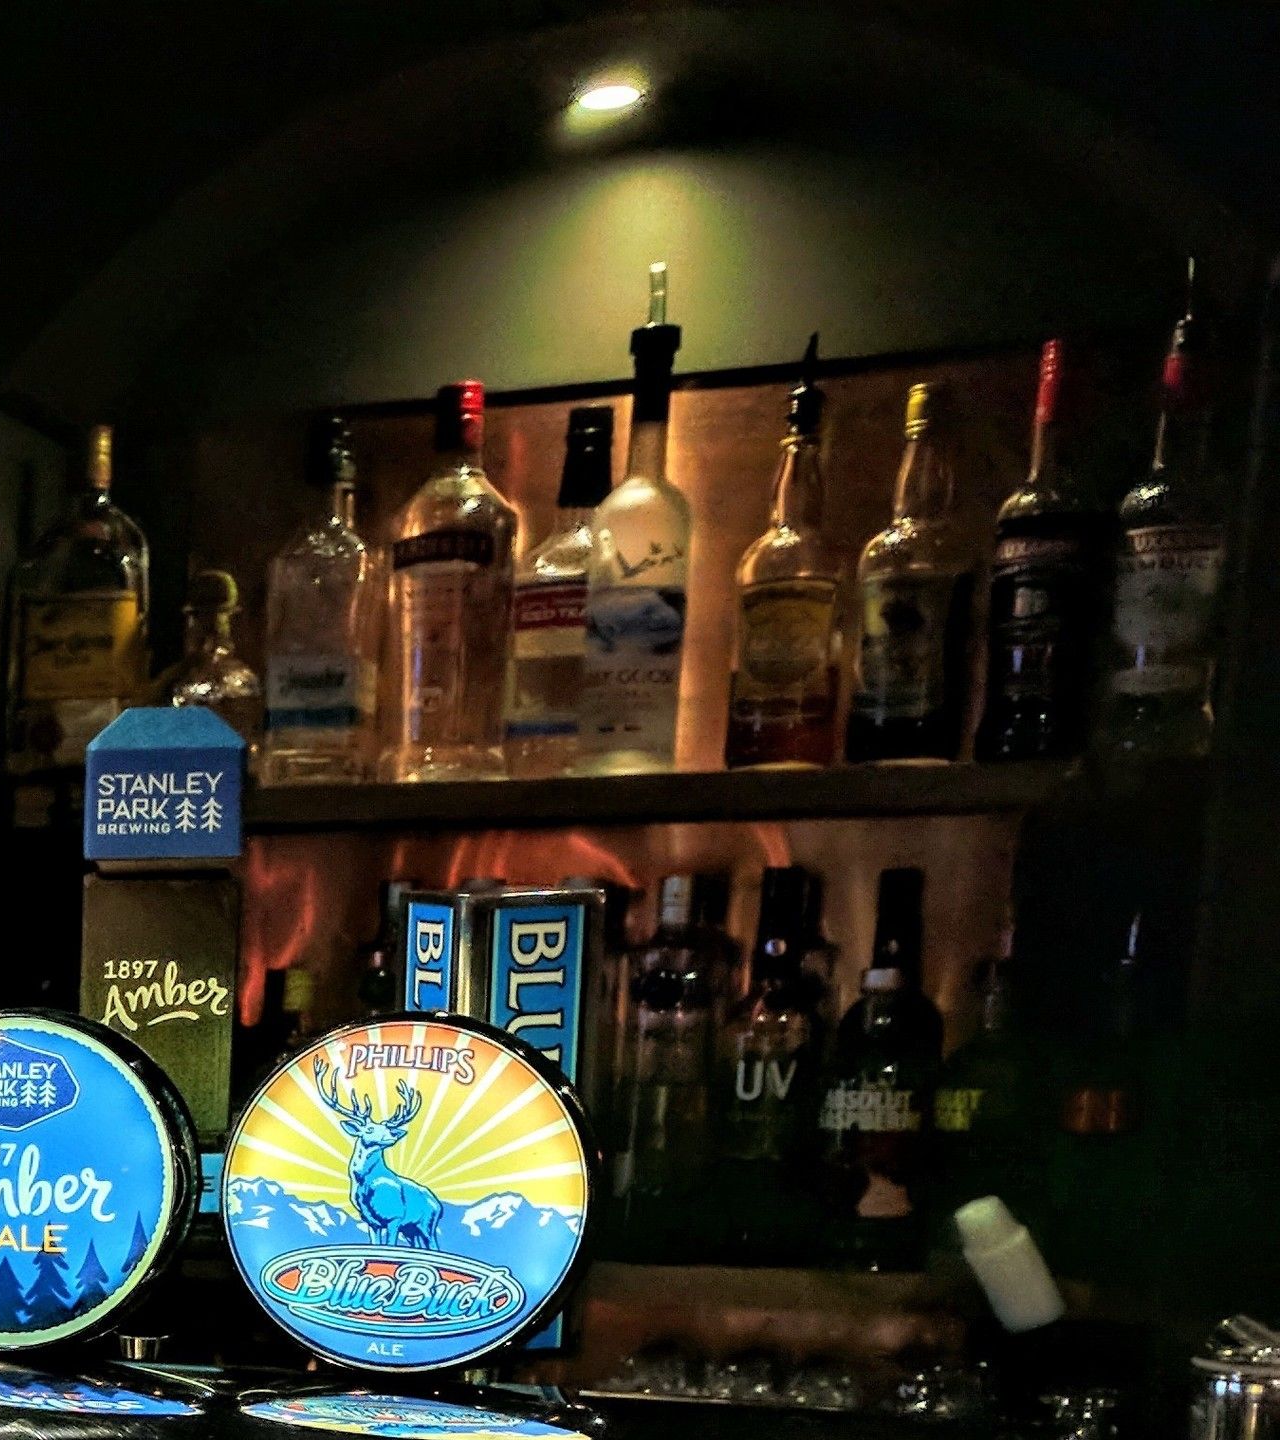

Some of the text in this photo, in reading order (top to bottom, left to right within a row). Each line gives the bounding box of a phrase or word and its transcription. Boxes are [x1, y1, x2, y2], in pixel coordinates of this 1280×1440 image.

[97, 771, 224, 796] STANLEY
[97, 798, 169, 820] PARK
[97, 823, 172, 835] BREWING
[104, 960, 159, 980] 1897
[100, 961, 229, 1032] Amber
[345, 1044, 477, 1085] PHILLIPS
[735, 1060, 798, 1102] UV
[298, 1258, 509, 1320] Blue Buck
[366, 1342, 404, 1357] ALE
